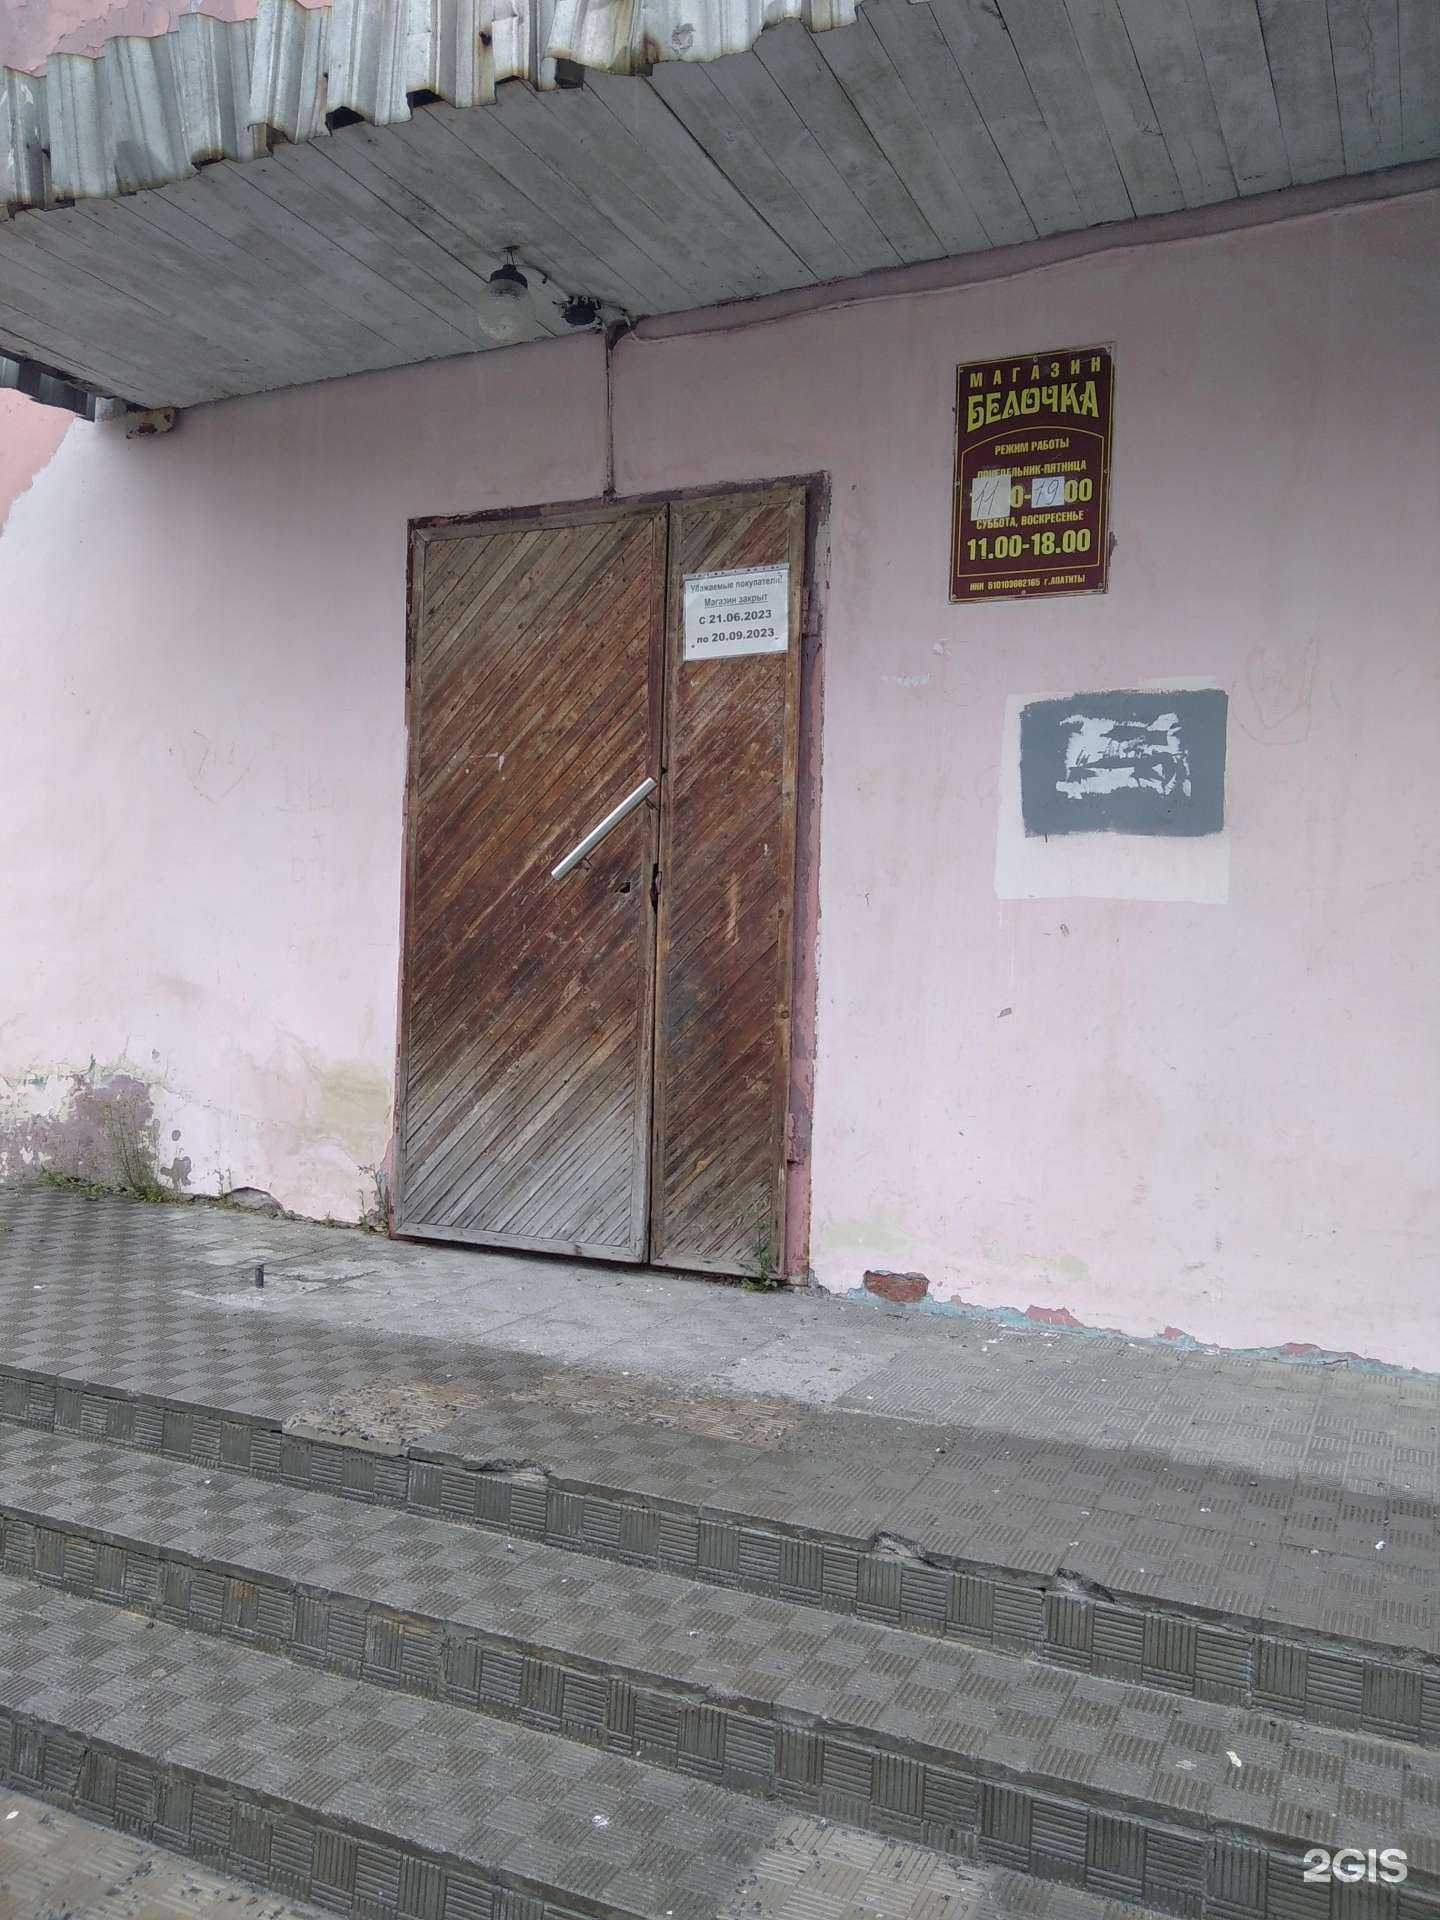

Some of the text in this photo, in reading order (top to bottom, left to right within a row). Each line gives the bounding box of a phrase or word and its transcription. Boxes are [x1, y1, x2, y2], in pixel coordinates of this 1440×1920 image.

[970, 356, 1101, 388] МАГАЗИН
[967, 380, 1100, 432] БЕЛОЧКА
[994, 437, 1070, 456] РЕЖИМ РАБОТЫ
[976, 510, 1085, 530] СУББОТА, ВОСКРЕСЕНЬЕ
[967, 528, 1091, 561] 11.00-18.00
[970, 582, 984, 591] ИНН
[704, 593, 768, 608] Магазин закрыт
[709, 609, 772, 624] 21.06.2023
[696, 628, 775, 644] по 20.09.2023
